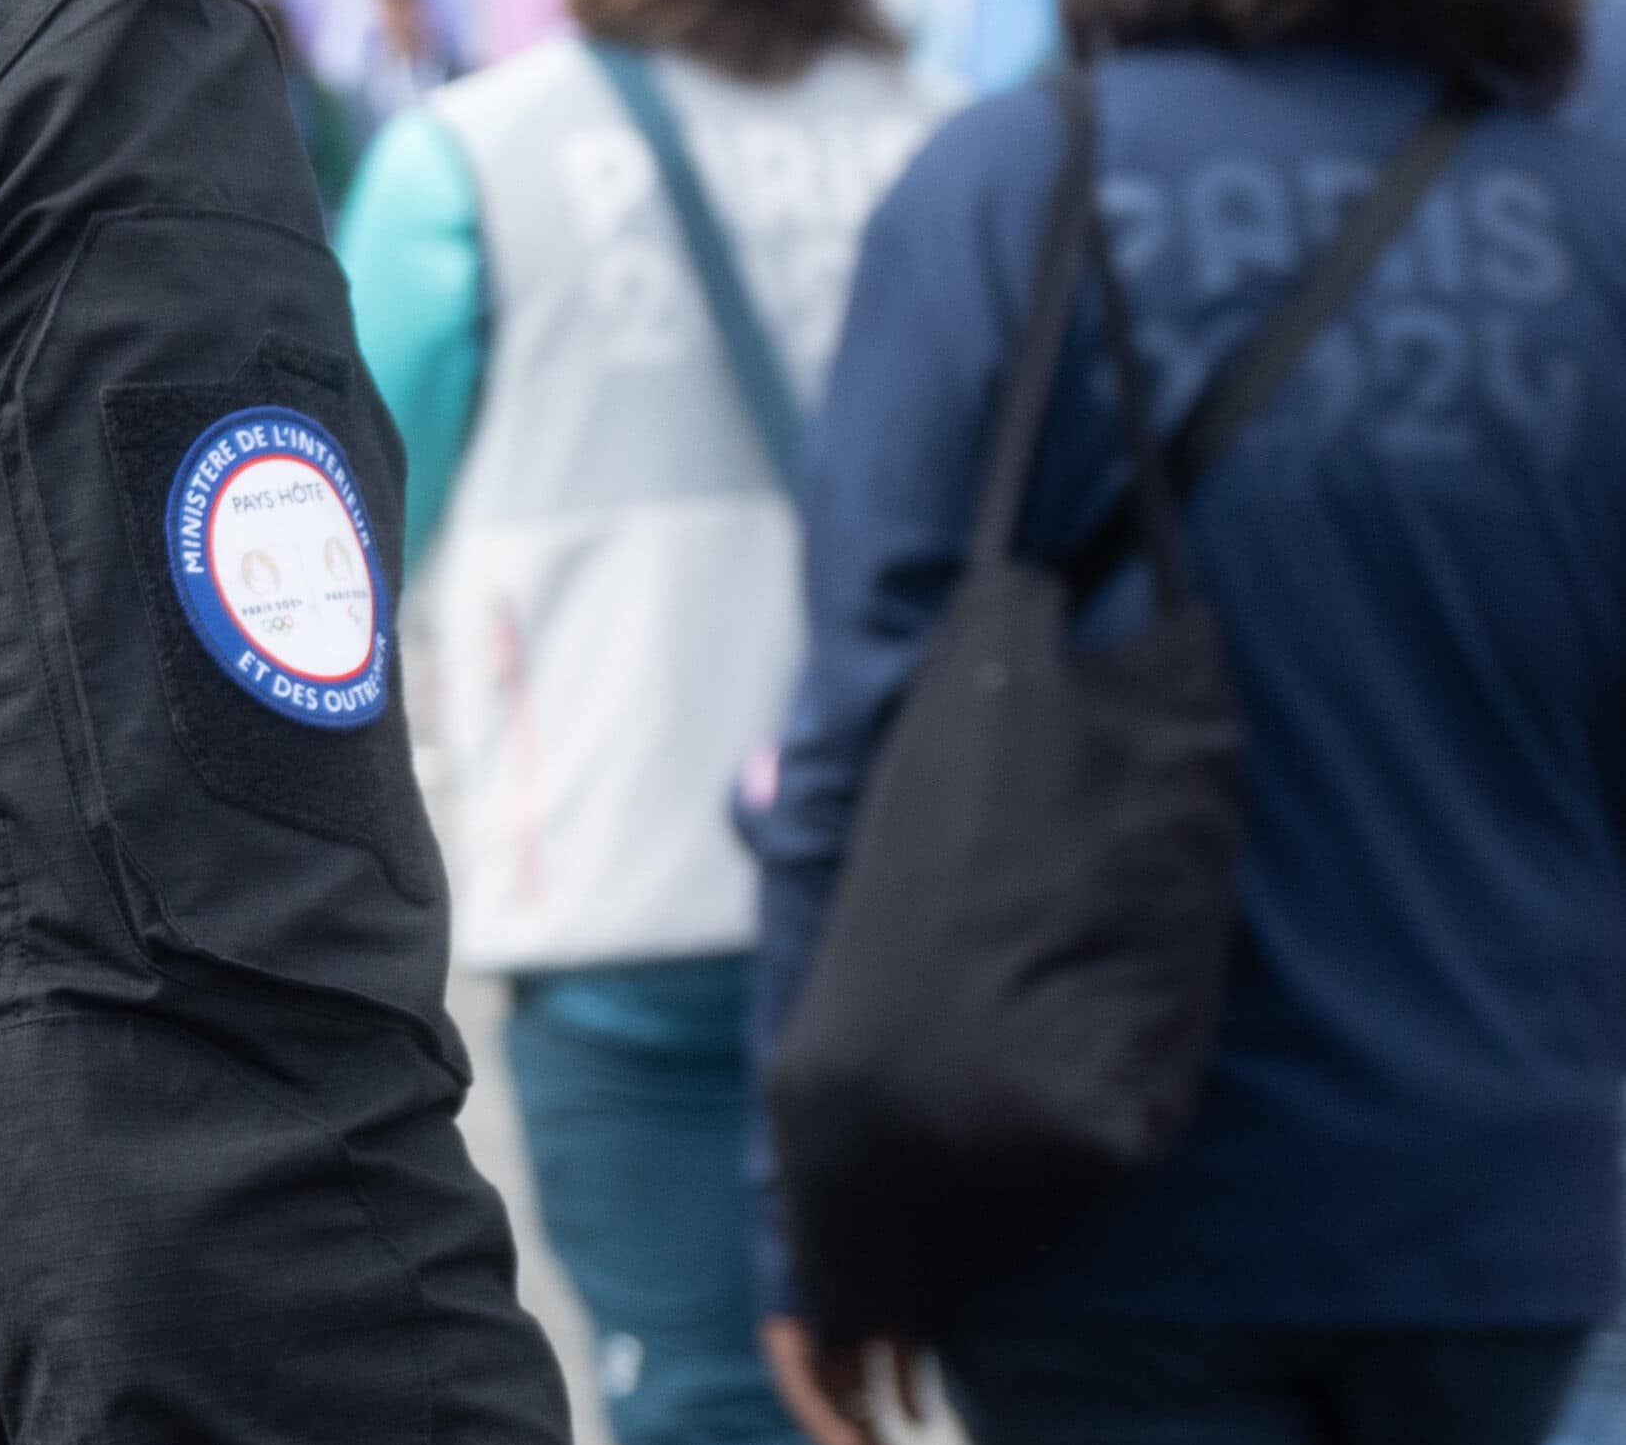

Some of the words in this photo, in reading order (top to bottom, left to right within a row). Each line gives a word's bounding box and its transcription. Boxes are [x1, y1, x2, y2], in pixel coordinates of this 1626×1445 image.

[180, 439, 237, 574] MINISTERE
[235, 425, 269, 453] DE
[232, 490, 275, 514] PAYS
[278, 480, 325, 506] HÔTE
[237, 650, 271, 682] ET
[273, 676, 319, 711] DES
